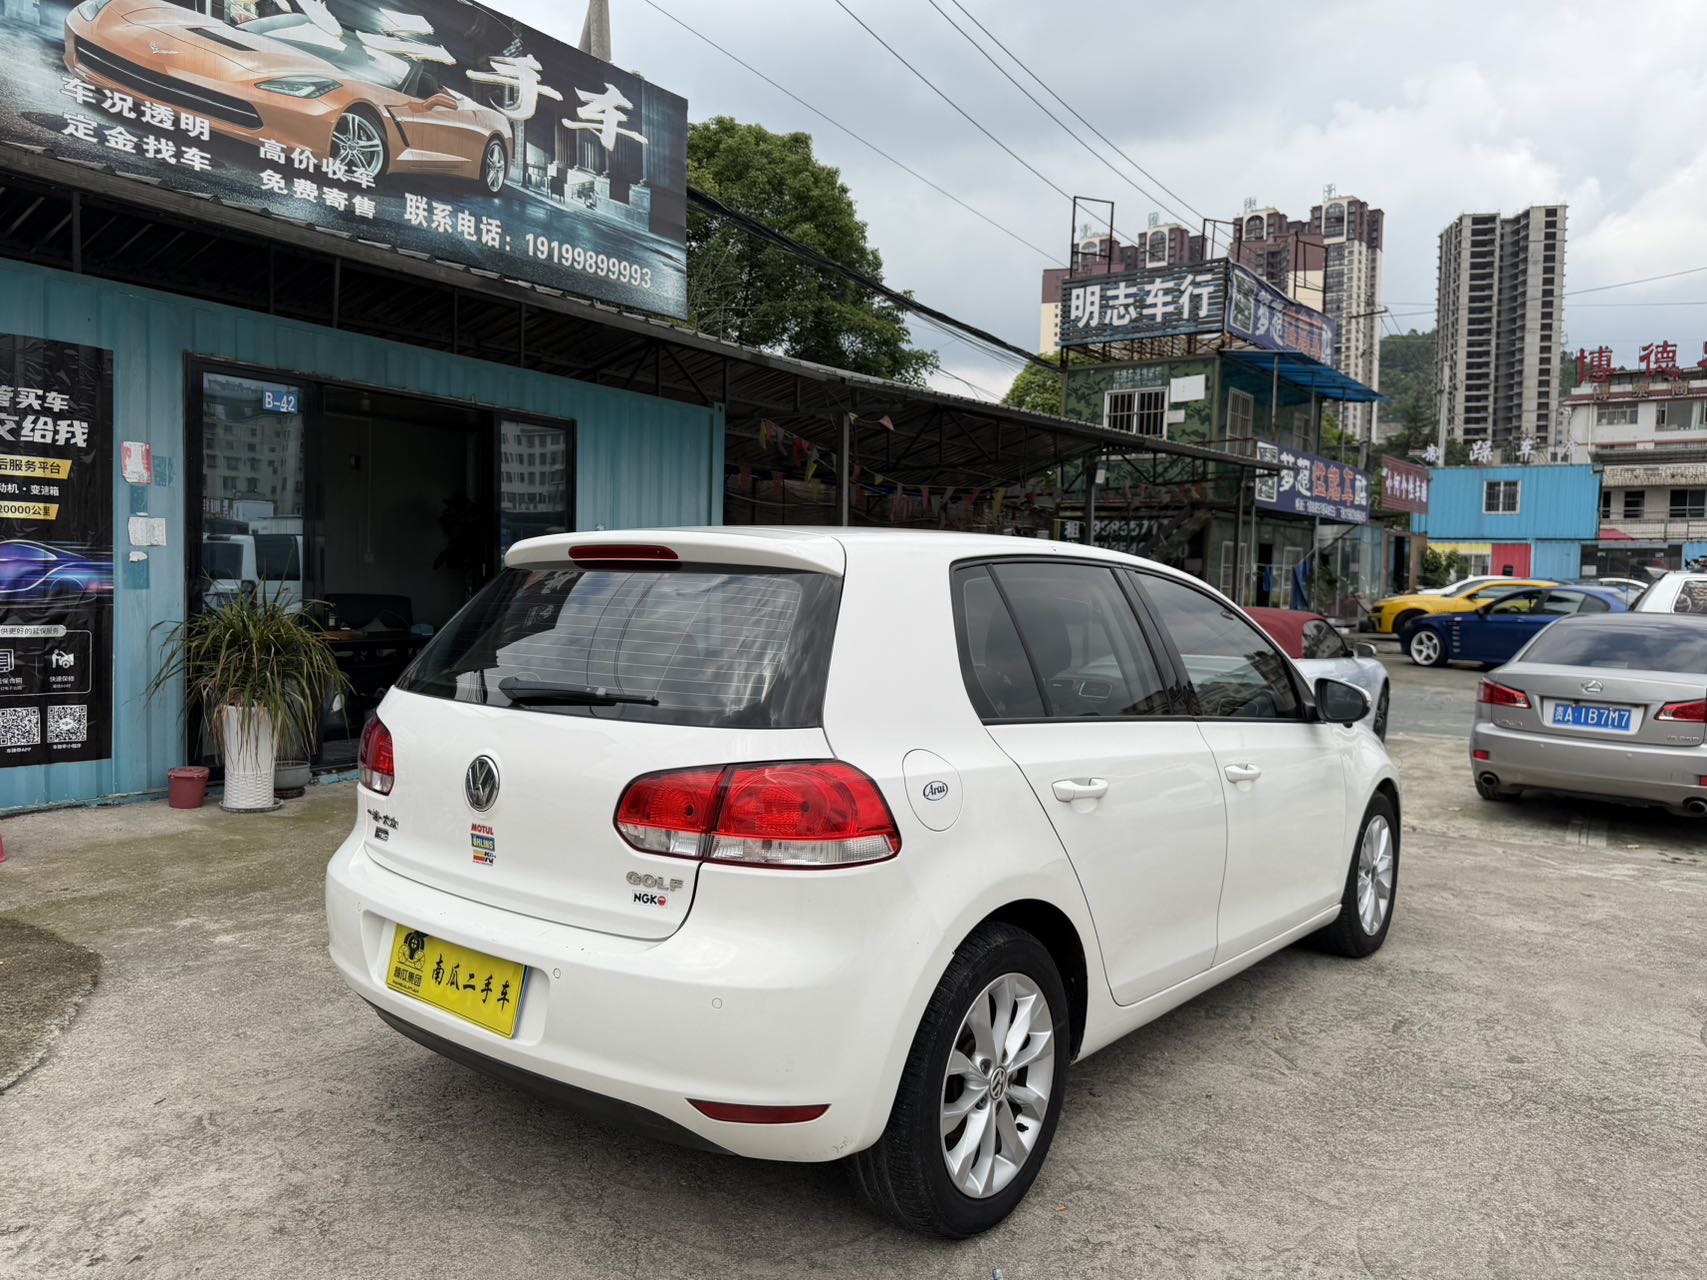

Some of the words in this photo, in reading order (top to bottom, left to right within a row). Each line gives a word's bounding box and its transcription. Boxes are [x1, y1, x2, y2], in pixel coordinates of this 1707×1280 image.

[273, 0, 648, 152] 二手车
[59, 74, 211, 142] 车况透明
[60, 111, 212, 173] 定金找车
[258, 138, 377, 191] 高价收车
[259, 168, 378, 221] 免费寄售
[1070, 272, 1216, 329] 明志车行
[1574, 339, 1707, 385] 博德
[265, 391, 295, 412] B-42
[471, 822, 494, 836] MOTUL
[626, 871, 684, 892] GOLF
[633, 892, 658, 905] NGK
[432, 953, 510, 1012] 南瓜二手车
